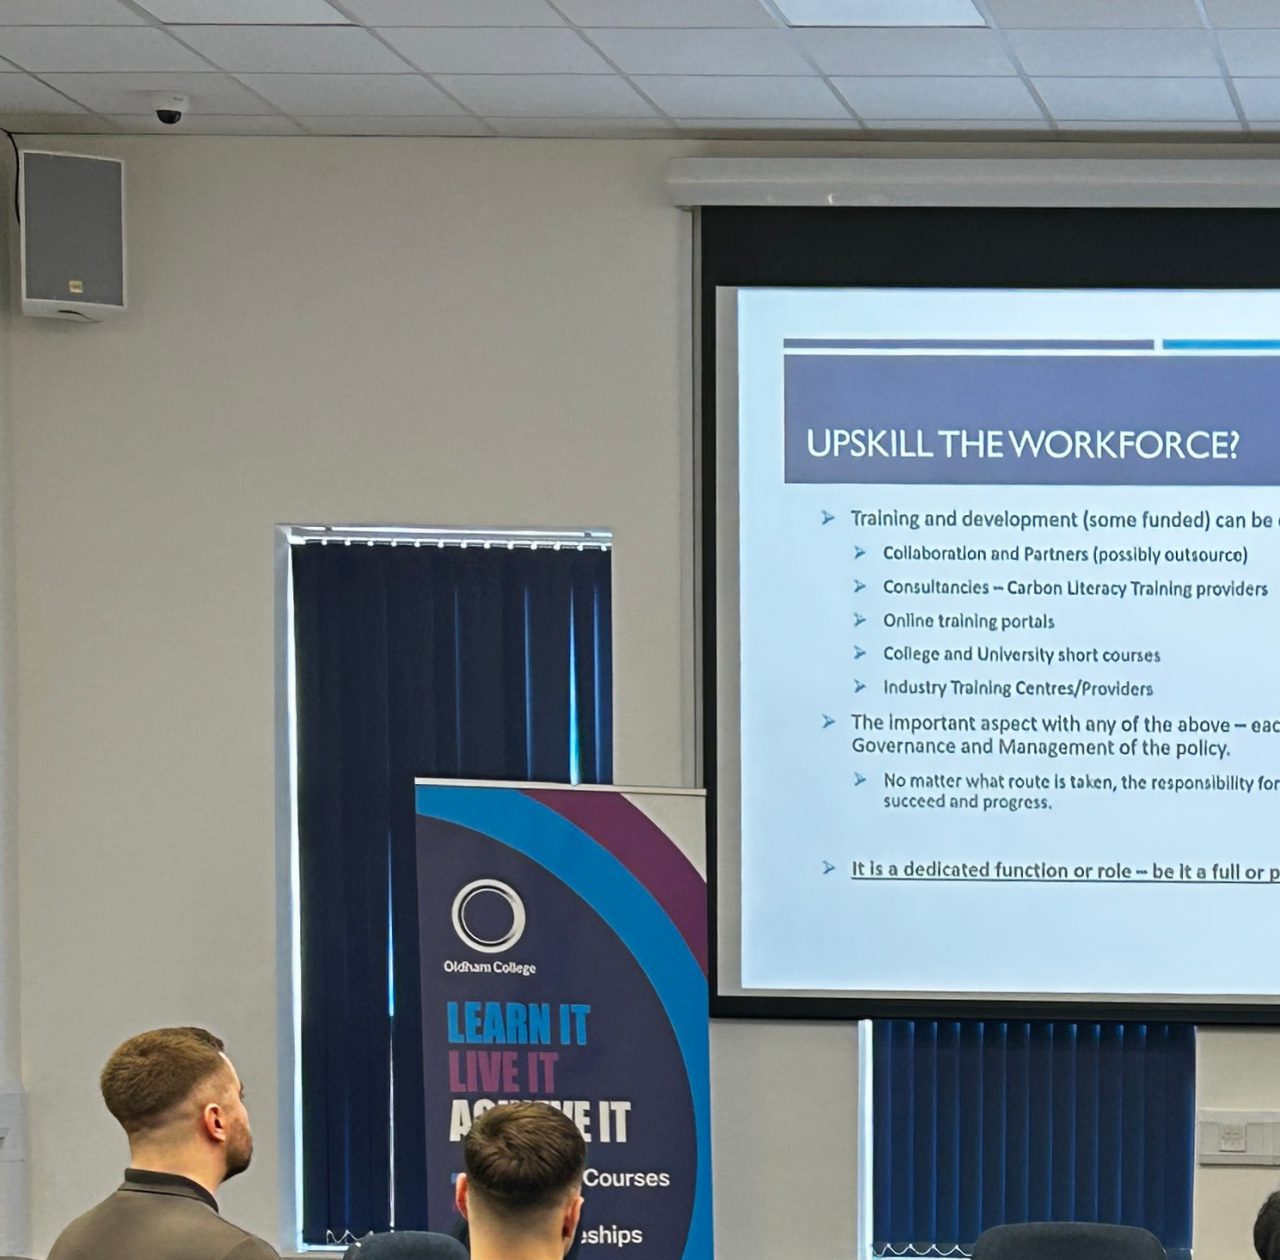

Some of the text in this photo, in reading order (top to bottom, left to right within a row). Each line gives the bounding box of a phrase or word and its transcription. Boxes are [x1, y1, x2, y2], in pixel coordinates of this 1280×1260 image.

[807, 428, 1241, 460] UPSKILL THE WORKFORCE?
[850, 508, 921, 531] Training
[924, 508, 957, 527] and
[961, 509, 1079, 532] development
[1082, 509, 1137, 532] (some
[1142, 509, 1211, 533] funded)
[1215, 515, 1246, 529] can
[1251, 510, 1273, 529] be
[883, 544, 1248, 566] Collaboration and Partners (possibly outsource)
[883, 578, 990, 595] Consultancies
[1007, 579, 1063, 596] Carbon
[1067, 579, 1127, 599] Literacy
[1129, 580, 1193, 600] Training
[1196, 580, 1269, 600] providers
[883, 612, 1056, 632] Online training portals
[883, 645, 1161, 666] College and University short courses
[884, 678, 1154, 699] Industry Training Centres/Providers
[850, 713, 884, 731] The
[889, 712, 977, 735] important
[980, 716, 1038, 738] aspect
[1041, 714, 1081, 733] with
[1085, 719, 1117, 737] any
[1121, 714, 1140, 734] of
[1143, 714, 1173, 734] the
[1177, 715, 1231, 734] above
[851, 737, 1231, 761] Governance and Management of the policy.
[884, 772, 906, 788] No
[910, 774, 963, 789] matter
[965, 772, 1005, 789] what
[1008, 775, 1050, 789] route
[1054, 773, 1066, 790] is
[1070, 773, 1117, 793] taken,
[1120, 774, 1147, 790] the
[1151, 774, 1255, 794] responsibility
[1257, 775, 1280, 791] for
[883, 794, 1053, 813] succeed and progress.
[852, 861, 864, 876] It
[870, 861, 883, 876] is
[889, 866, 898, 876] a
[904, 861, 990, 877] dedicated
[995, 862, 1068, 878] function
[1074, 866, 1093, 878] or
[1098, 863, 1132, 878] role
[1153, 863, 1174, 879] be
[1180, 863, 1192, 879] it
[1197, 868, 1206, 879] a
[1212, 864, 1240, 879] full
[1245, 869, 1265, 879] or
[443, 960, 537, 976] Oldham College
[447, 1001, 592, 1046] LEARN IT
[449, 1050, 560, 1094] LIVE IT
[598, 1101, 632, 1143] IT
[582, 1168, 671, 1187] Courses
